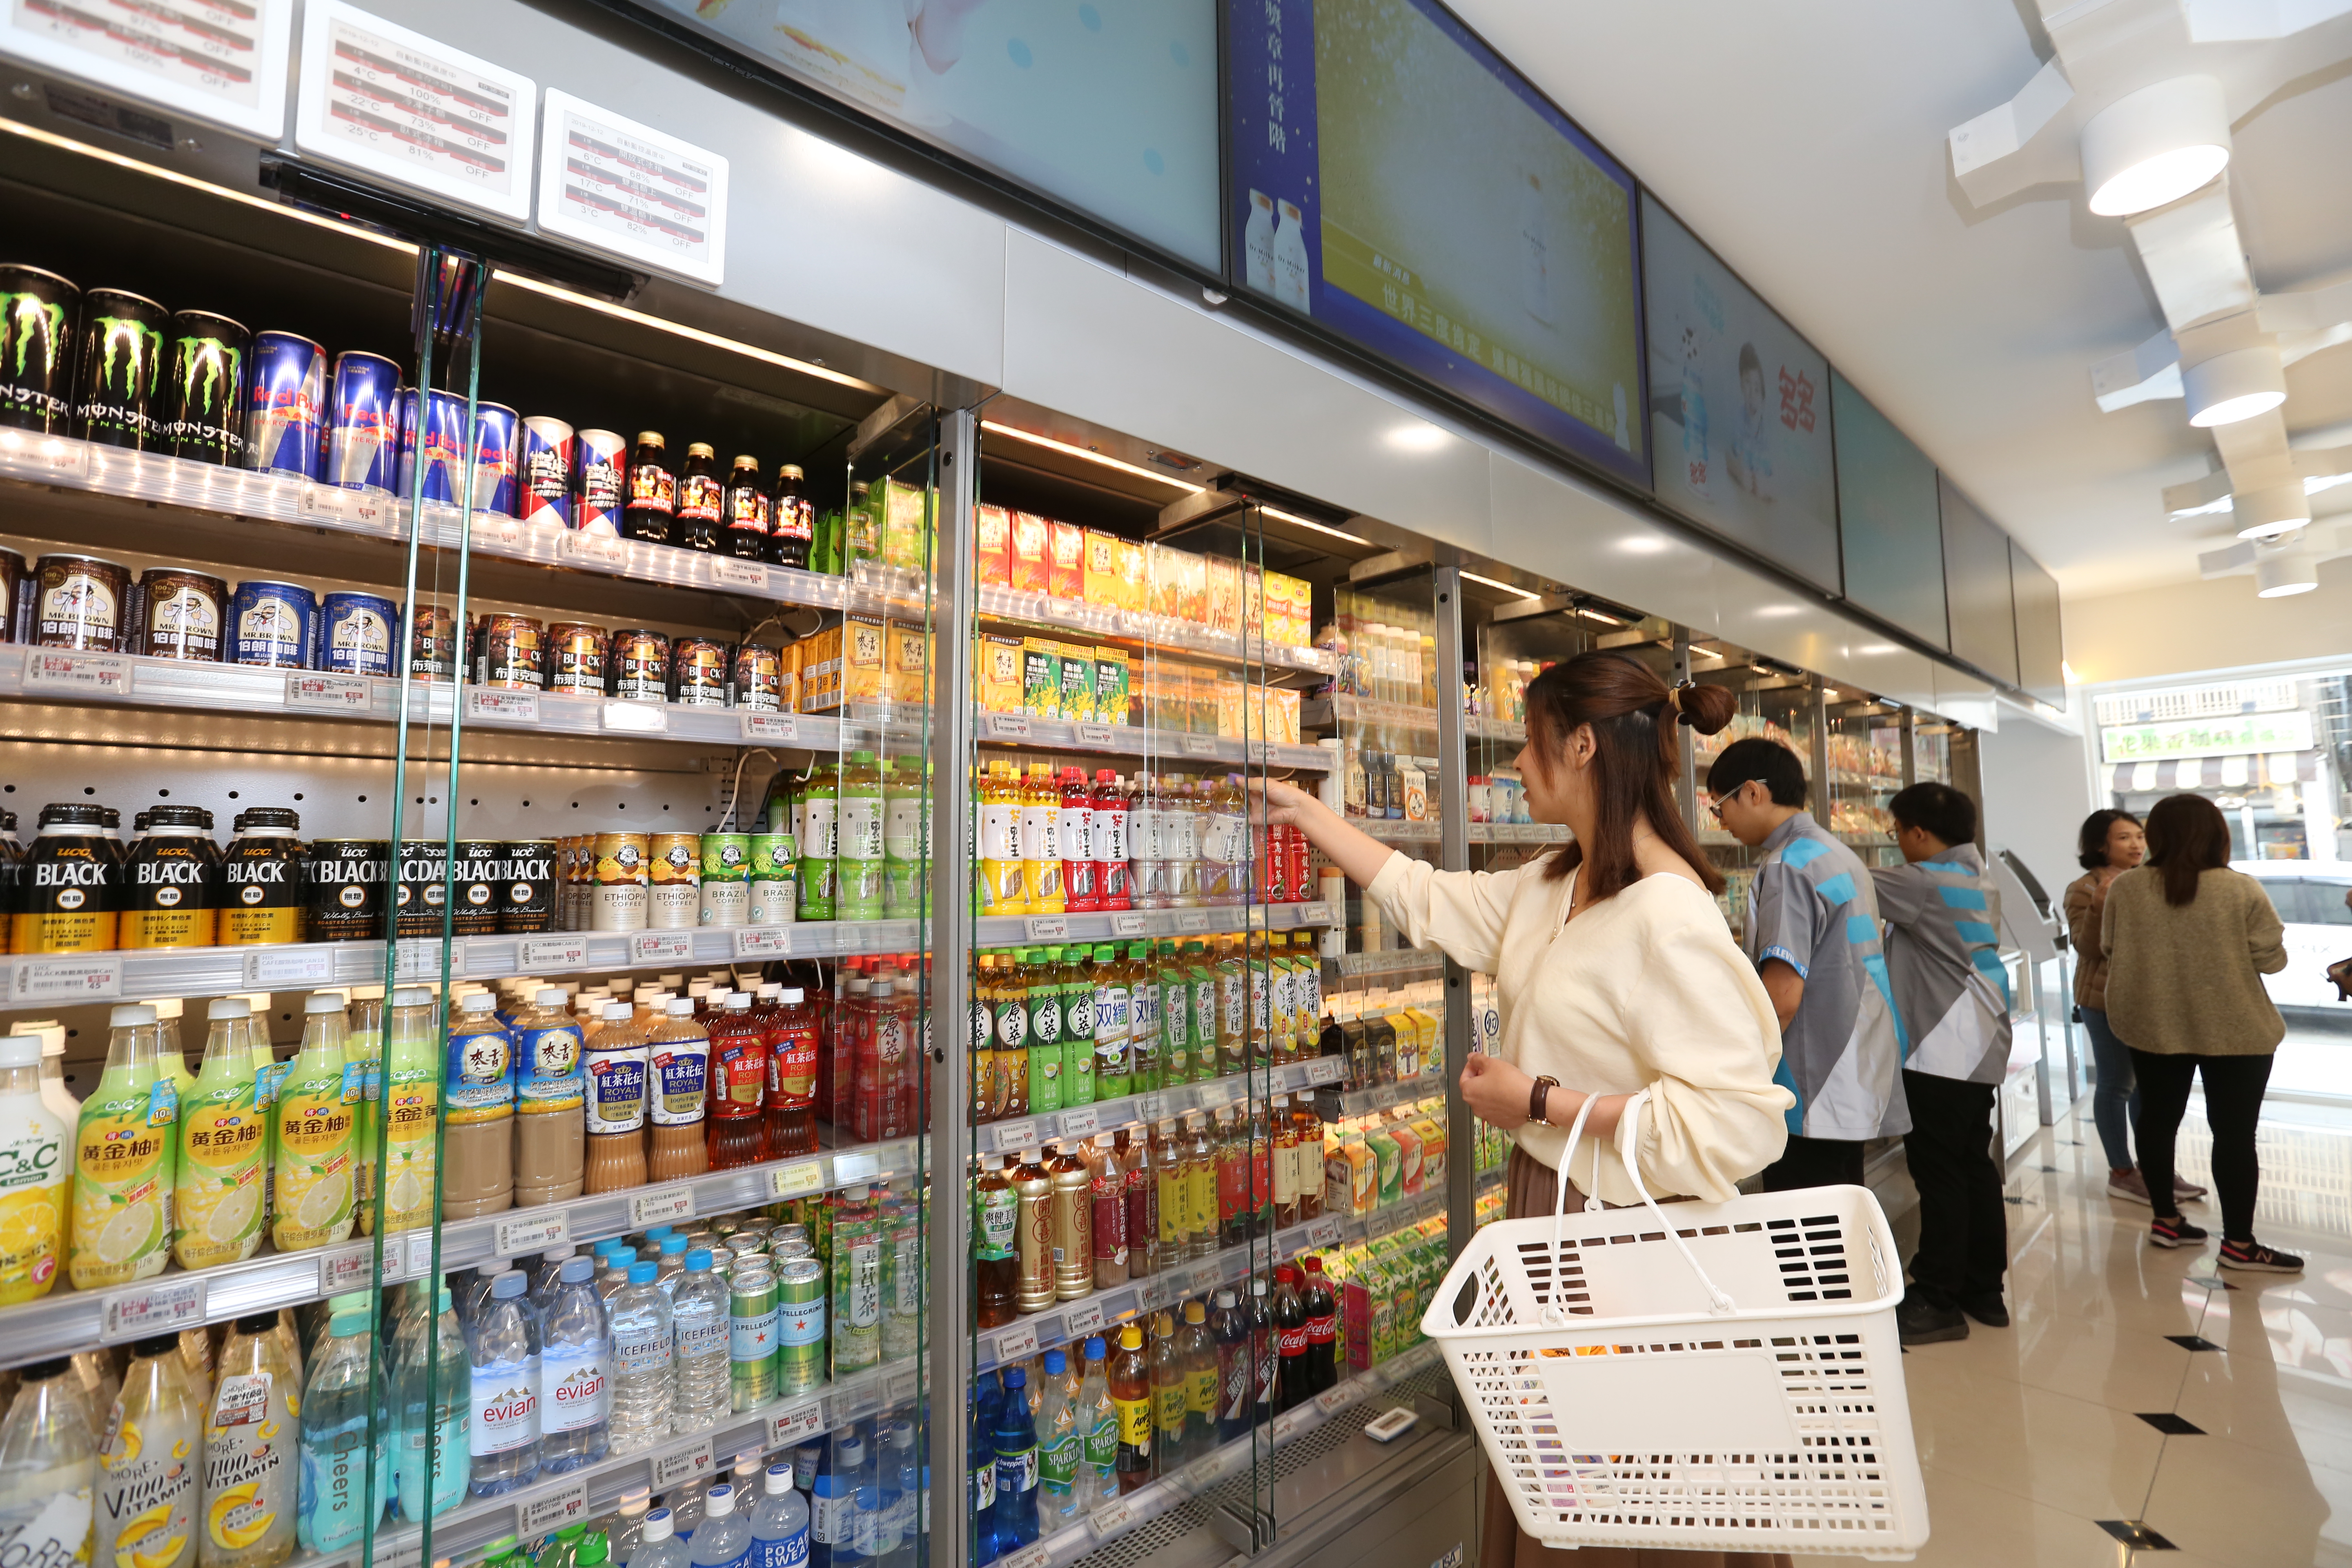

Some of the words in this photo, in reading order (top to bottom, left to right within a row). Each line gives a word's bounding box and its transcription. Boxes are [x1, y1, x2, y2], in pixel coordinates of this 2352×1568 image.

[354, 66, 376, 80] 4°C
[346, 94, 380, 111] -22°C
[409, 86, 441, 106] 100%
[410, 116, 436, 132] 73%
[469, 109, 492, 123] OFF
[344, 124, 378, 141] -25°C
[467, 138, 491, 151] OFF
[409, 145, 434, 161] 81%
[583, 152, 601, 165] 6°C
[619, 149, 663, 173] 開放式冰箱
[466, 165, 489, 179] OFF
[629, 170, 650, 183] 68%
[579, 178, 603, 192] 17°C
[675, 187, 694, 200] OFF
[628, 195, 649, 209] 71%
[581, 205, 599, 218] 3°C
[673, 212, 693, 224] OFF
[627, 222, 647, 235] 82%
[672, 237, 691, 250] OFF
[253, 385, 292, 404] Red
[87, 419, 158, 442] ENERGY
[163, 419, 244, 452] MONSTER
[170, 436, 237, 455] ENERGY
[653, 496, 672, 510] 200
[700, 506, 719, 519] 200
[796, 526, 811, 538] 200
[42, 621, 114, 640] 伯朗咖啡
[243, 631, 295, 641] MR.BROWN
[238, 640, 298, 655] 伯朗咖啡
[1026, 637, 1034, 645] 20%
[1034, 638, 1048, 647] EXTRA
[1048, 639, 1059, 648] FREE
[1070, 645, 1082, 653] EXTRA
[1083, 647, 1093, 655] FREE
[332, 648, 388, 665] 伯朗咖啡
[996, 650, 1015, 669] 麥香
[1106, 648, 1118, 656] EXTRA
[1026, 665, 1050, 674] 泡沫綠茶
[1027, 656, 1047, 667] 生活
[495, 667, 544, 684] 布萊克咖啡
[553, 673, 605, 688] 布萊克咖啡
[617, 679, 666, 693] 布萊克咖啡
[1081, 811, 1092, 857] 茶裏王
[501, 859, 551, 880] BLACK
[1274, 843, 1283, 882] 烏龍茶
[35, 863, 108, 886] BLACK
[136, 862, 204, 884] BLACK
[227, 862, 286, 883] BLACK
[319, 860, 378, 883] BLACK
[604, 893, 646, 901] ETHIOPIA
[712, 890, 746, 898] BRAZIL
[1307, 973, 1319, 1013] 御茶園
[1039, 997, 1058, 1044] 原萃
[469, 1048, 503, 1074] 麥香
[601, 1071, 642, 1088] 紅茶花伝
[665, 1064, 704, 1080] 紅茶花伝
[212, 1087, 240, 1099] C&C
[604, 1086, 638, 1096] ROYAL
[7, 1174, 43, 1185] Lemon
[122, 1182, 138, 1194] NEW
[129, 1179, 156, 1204] 期間限定
[984, 1208, 1016, 1226] 爽健美茶
[778, 1304, 823, 1318] S.PELLEGRINO
[681, 1320, 728, 1341] ICEFIELD
[619, 1337, 670, 1356] ICEFIELD
[555, 1376, 604, 1401] evian
[483, 1396, 536, 1422] evian
[333, 1430, 358, 1512] Cheers
